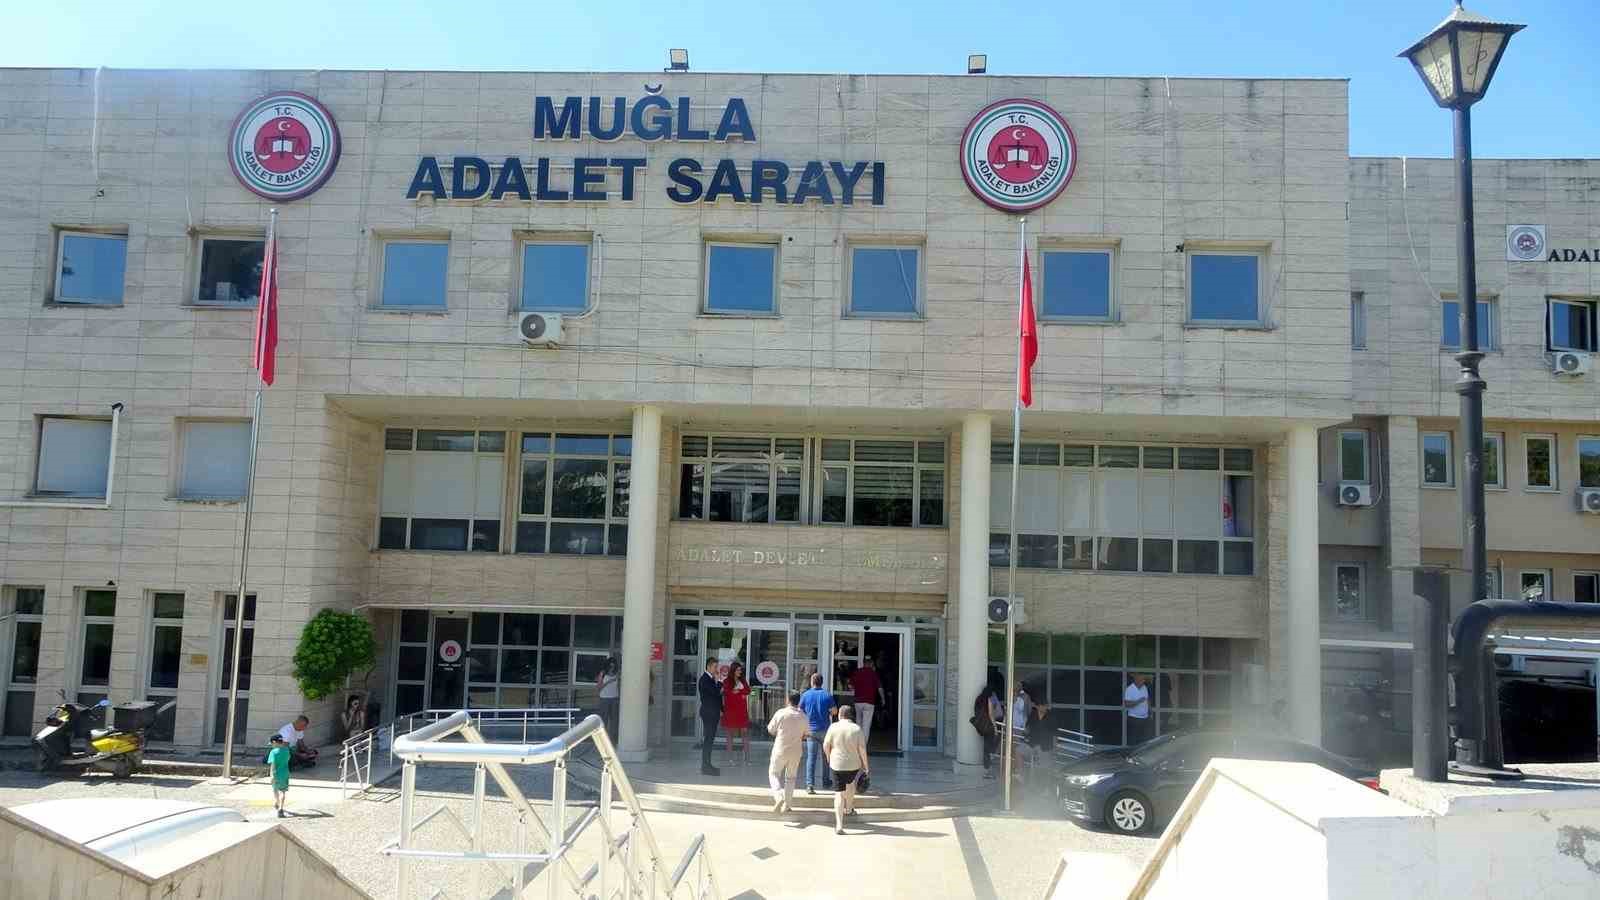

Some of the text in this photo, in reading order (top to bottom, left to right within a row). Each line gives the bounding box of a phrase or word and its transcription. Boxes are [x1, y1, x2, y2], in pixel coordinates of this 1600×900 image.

[274, 106, 294, 117] T.C.
[534, 84, 756, 143] MUĞLA
[1008, 114, 1030, 125] T.C.
[244, 146, 322, 184] ADALET BAKANLIĞI
[406, 156, 886, 208] ADALET SARAYI
[977, 156, 1060, 194] ADALET BAKANLIĞI
